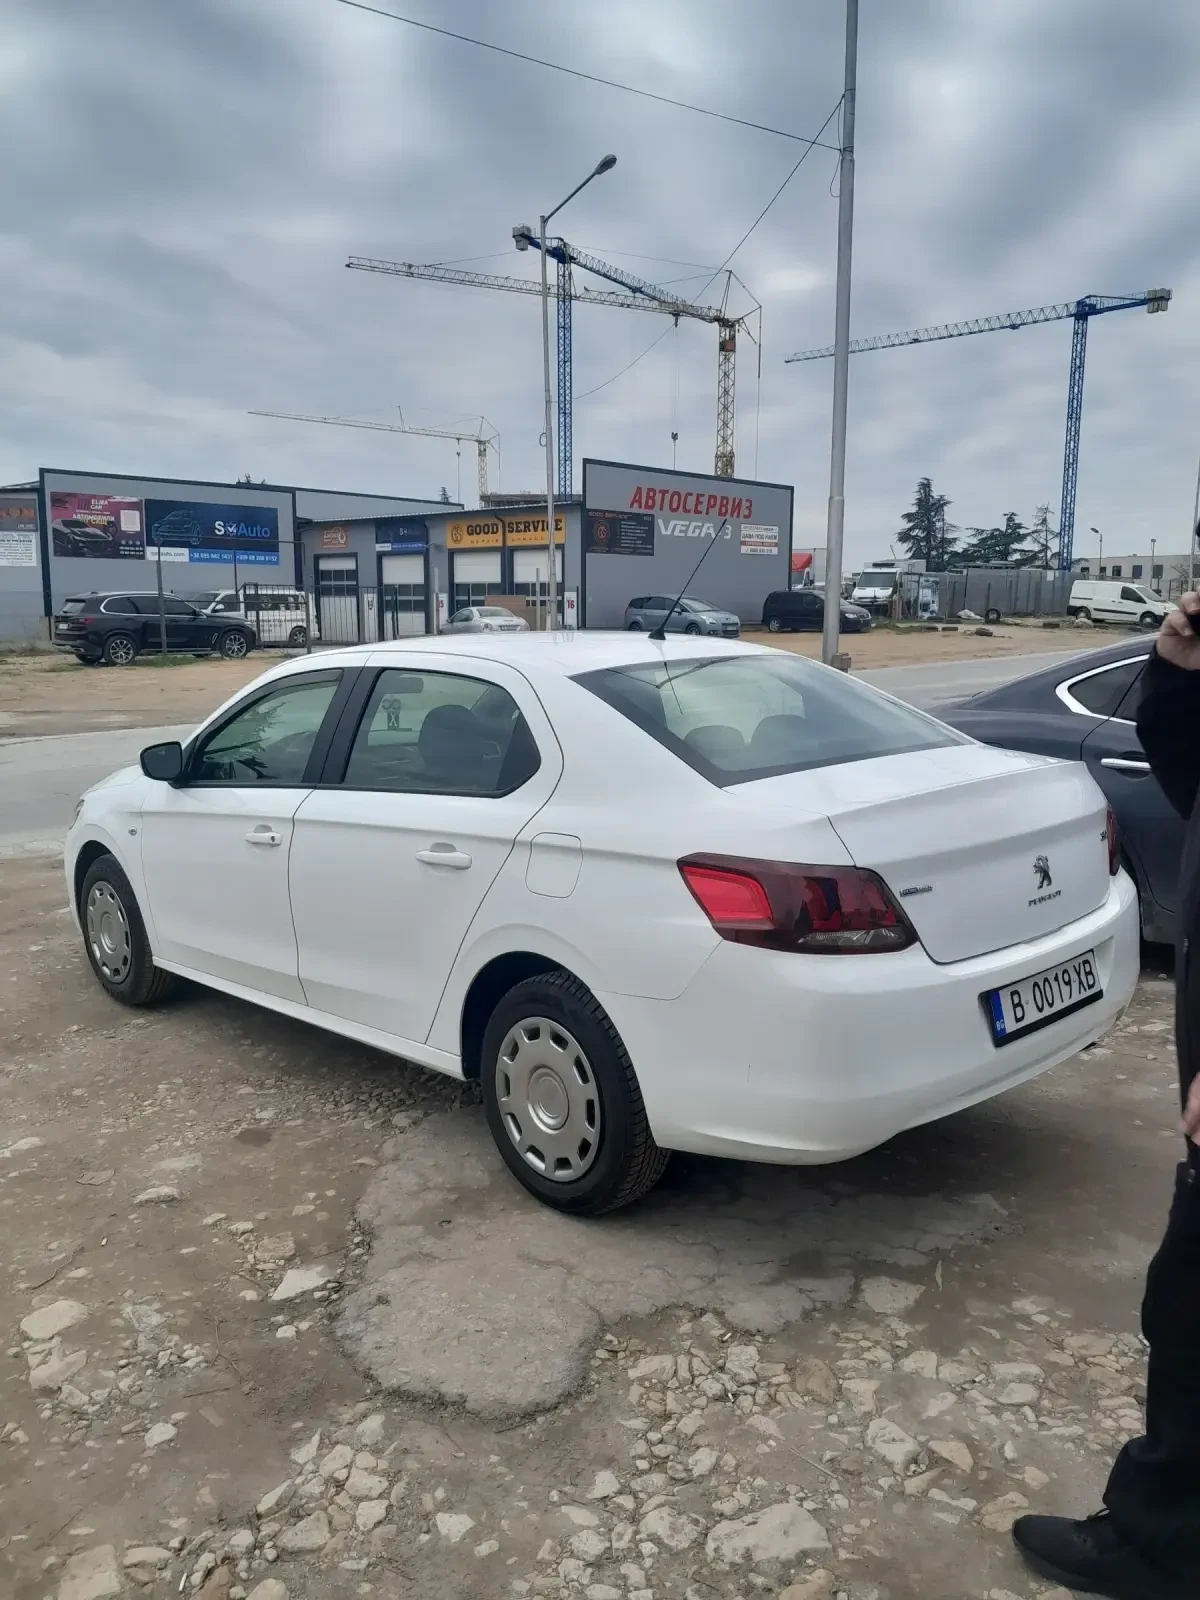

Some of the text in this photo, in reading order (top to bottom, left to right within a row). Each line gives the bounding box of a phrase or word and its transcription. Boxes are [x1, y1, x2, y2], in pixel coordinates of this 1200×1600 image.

[630, 486, 753, 520] АВТОСЕРВИЗ
[466, 523, 499, 536] GOOD
[567, 600, 575, 609] 16
[1010, 959, 1096, 1024] B 0019 XB
[996, 1020, 1004, 1031] BG
